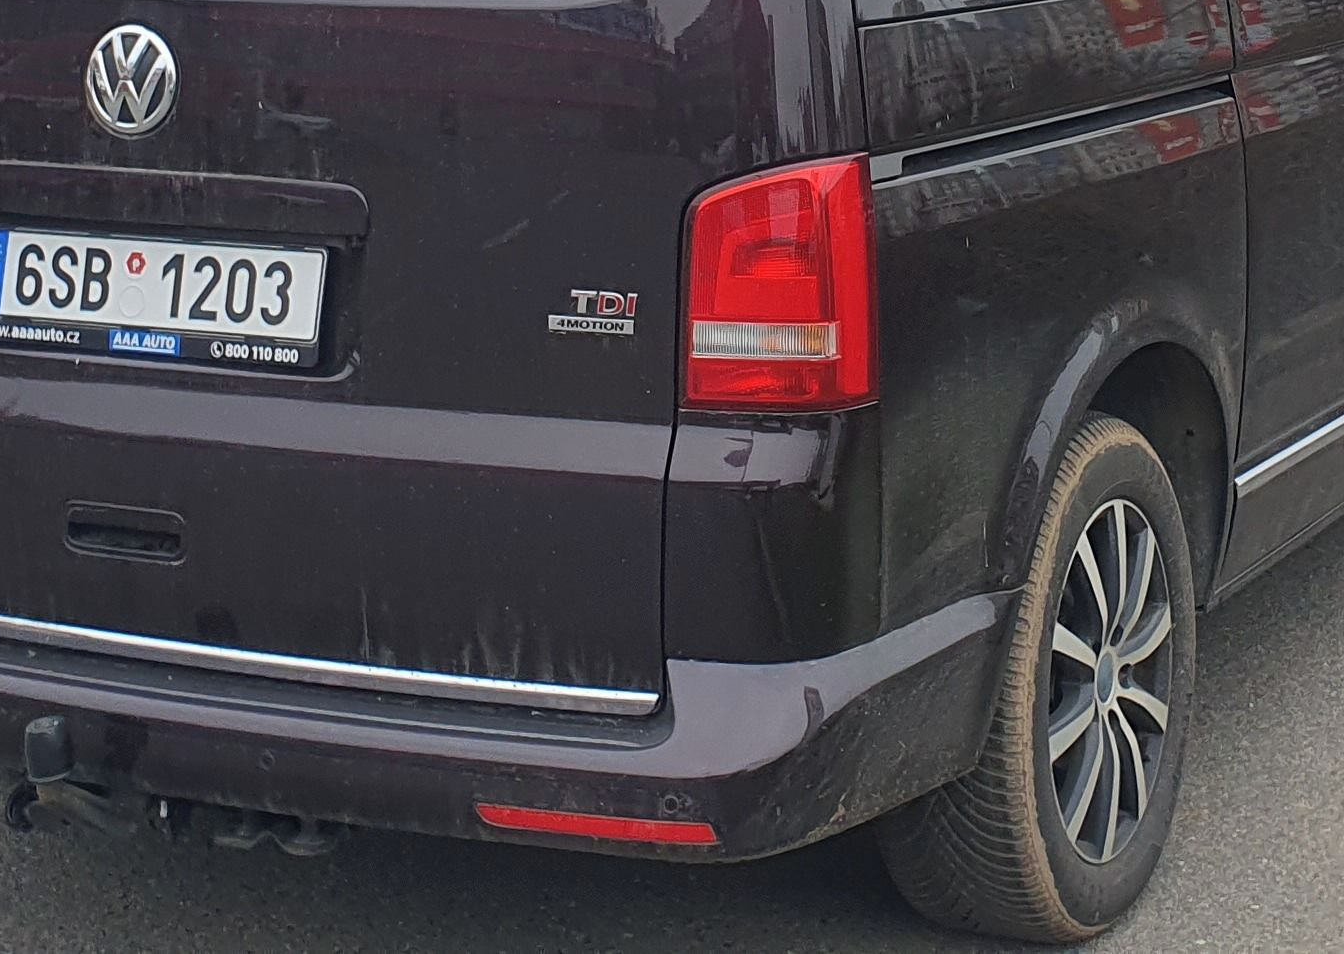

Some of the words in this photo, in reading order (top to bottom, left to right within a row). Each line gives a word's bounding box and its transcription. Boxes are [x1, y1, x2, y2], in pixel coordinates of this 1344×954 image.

[15, 243, 113, 312] 6SB
[161, 253, 293, 326] 1203
[570, 289, 638, 317] TDI
[556, 319, 625, 332] 4MOTION
[112, 332, 140, 347] AAA
[142, 333, 175, 350] AUTO
[225, 343, 249, 359] 800
[251, 346, 273, 362] 110
[274, 348, 299, 364] 800
